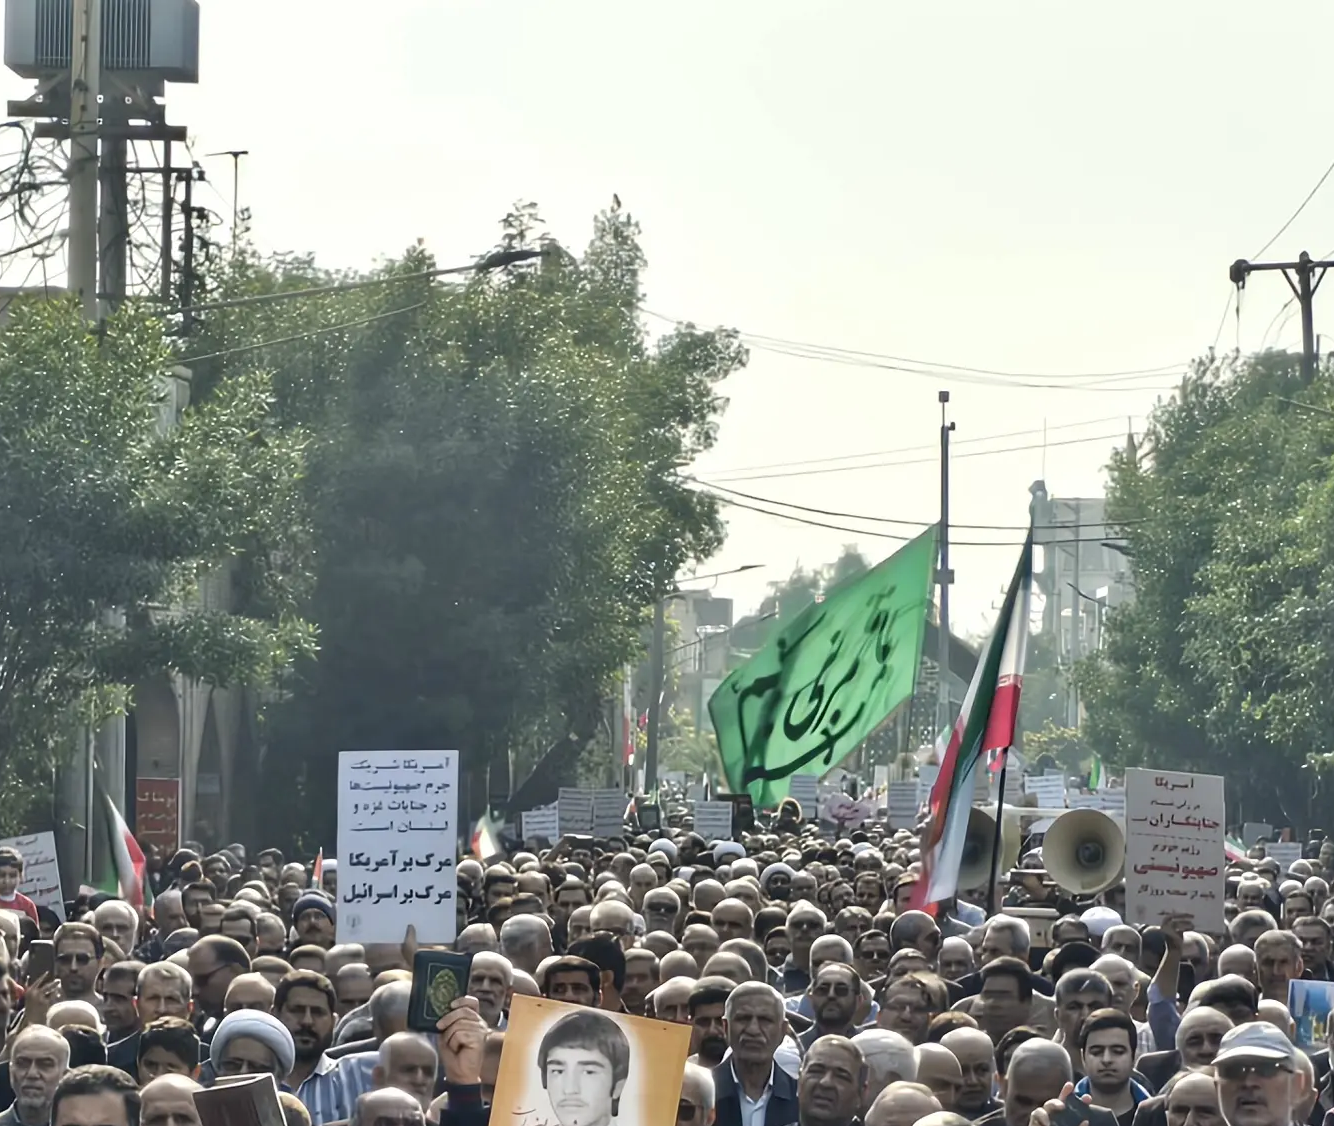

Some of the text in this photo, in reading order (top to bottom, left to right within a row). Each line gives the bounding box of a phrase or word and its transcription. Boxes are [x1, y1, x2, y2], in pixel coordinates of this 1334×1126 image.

[353, 800, 447, 815] در جنایات غزه و
[349, 850, 452, 872] مرگ بر آمریکا
[343, 883, 452, 905] مرگ بر اسرائیل
